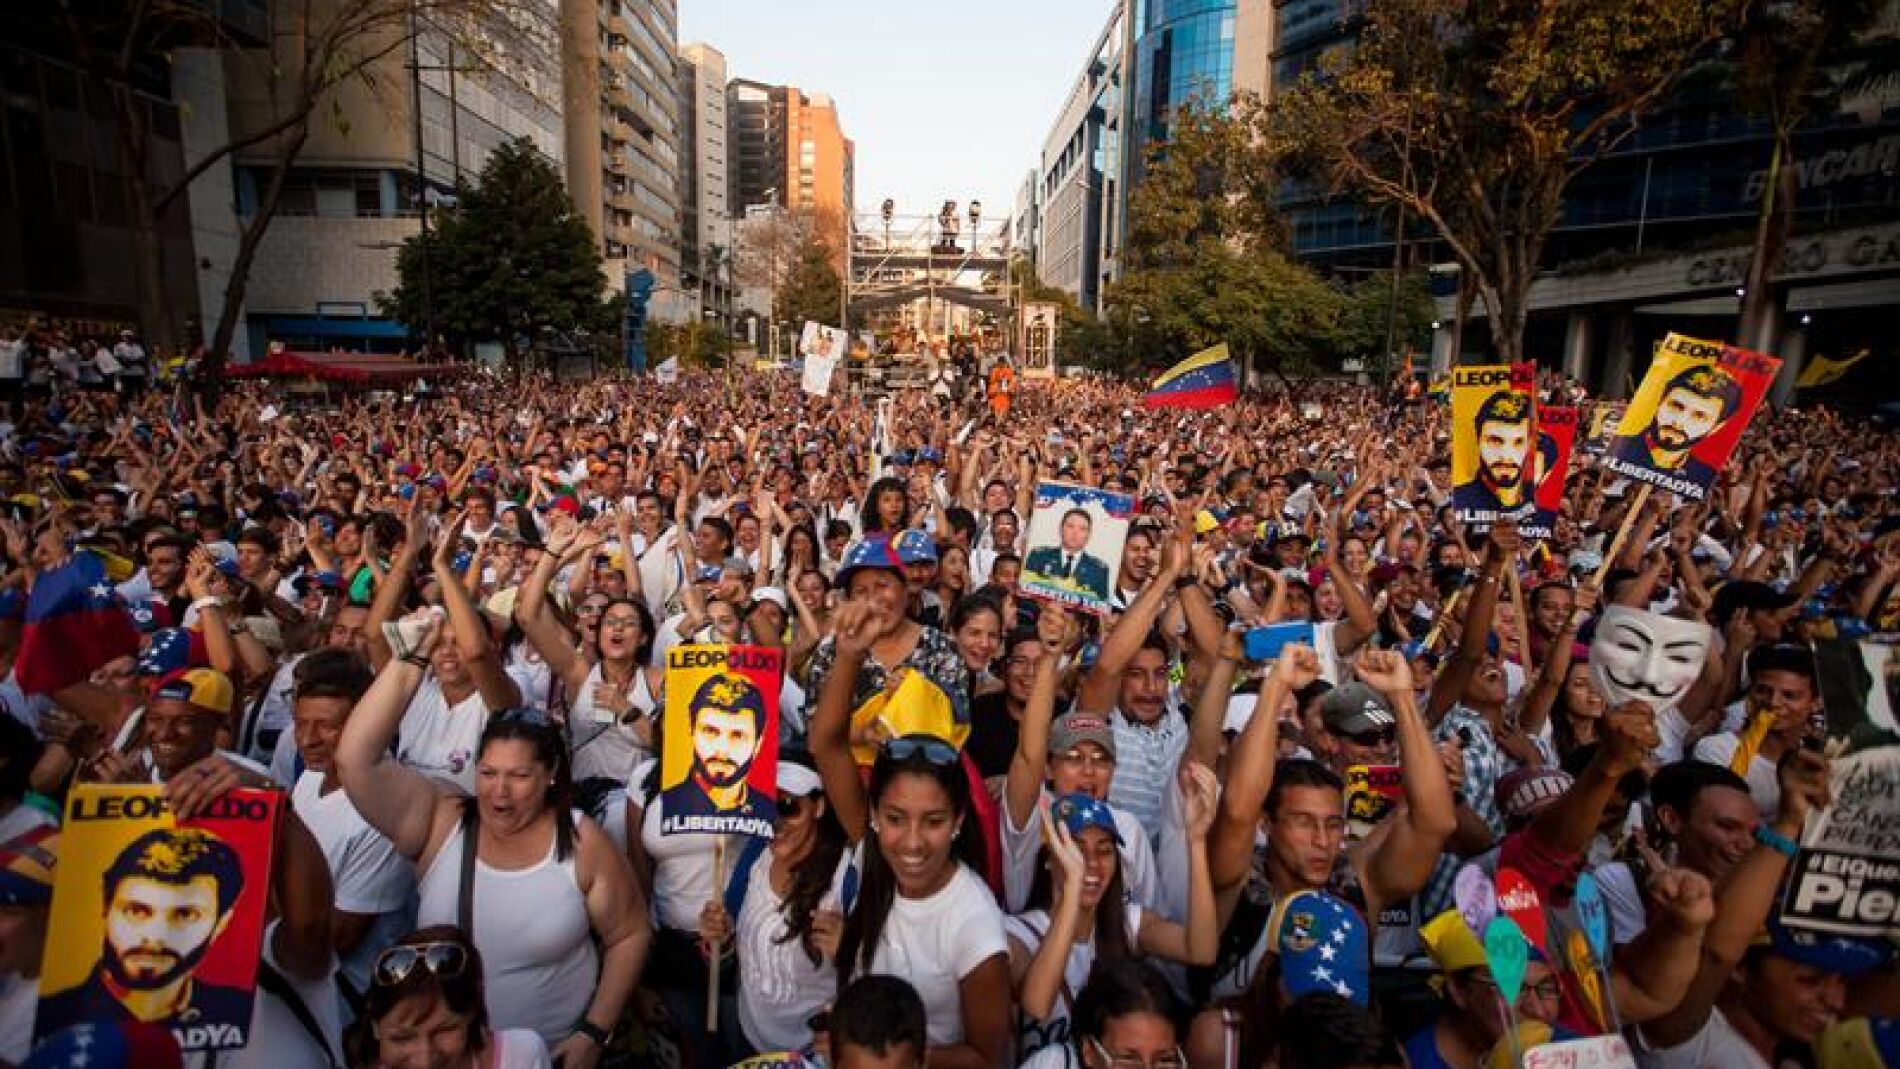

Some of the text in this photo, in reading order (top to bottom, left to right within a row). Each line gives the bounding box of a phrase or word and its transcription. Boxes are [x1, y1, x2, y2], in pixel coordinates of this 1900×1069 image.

[1689, 241, 1825, 286] CENRO
[1664, 339, 1775, 376] LEOPOLDO
[1601, 455, 1704, 500] #LIBERTADYA
[669, 650, 777, 669] LEOPOLDO
[662, 814, 774, 838] #LIBERTADYA
[1795, 873, 1900, 922] Pie
